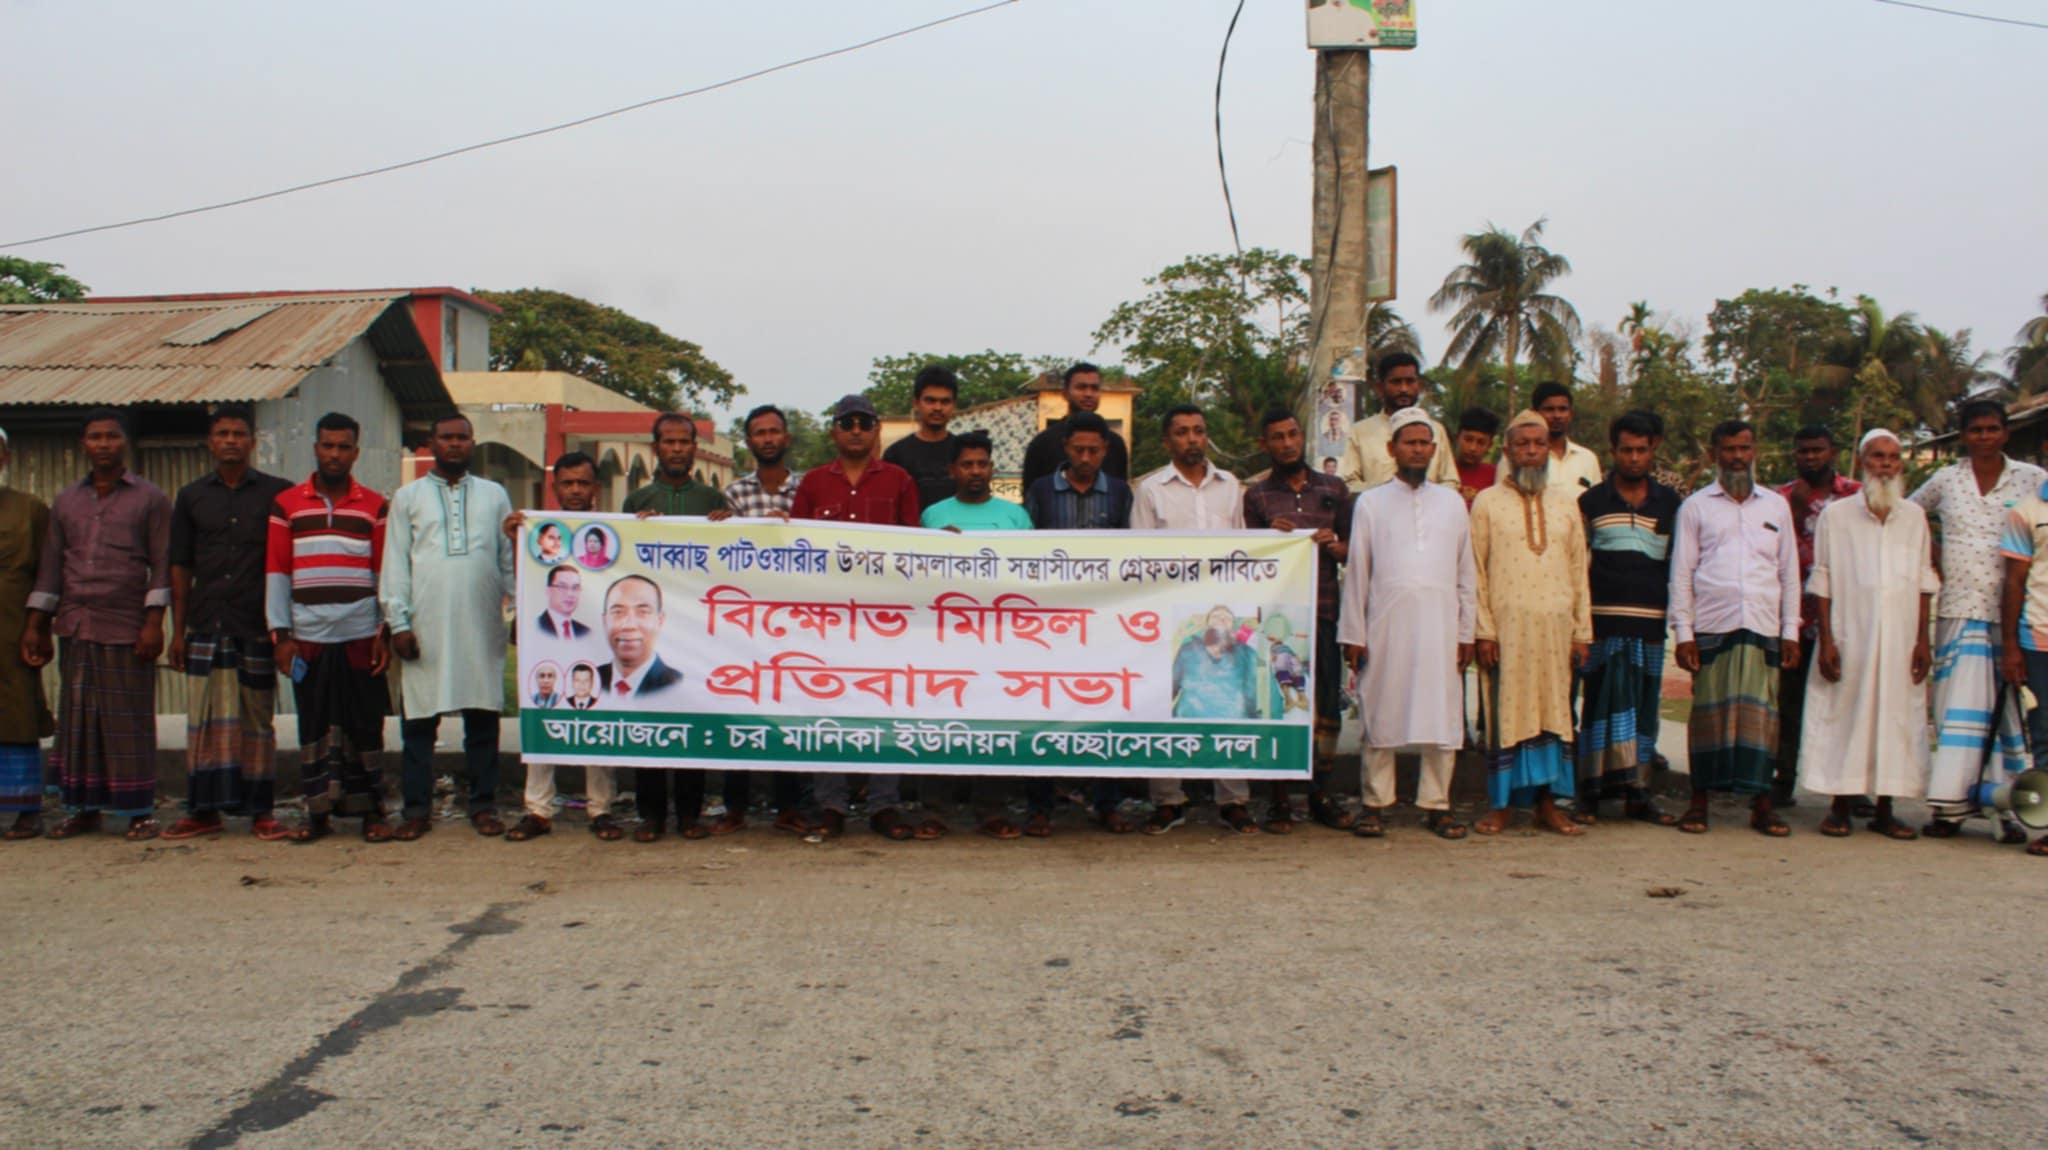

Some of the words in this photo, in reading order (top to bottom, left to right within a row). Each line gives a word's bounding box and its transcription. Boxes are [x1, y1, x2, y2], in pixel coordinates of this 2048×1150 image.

[635, 541, 709, 573] আব্বাছ
[717, 538, 829, 574] পাটওয়ারীর
[836, 541, 886, 577] উপর
[894, 548, 999, 581] হামলাকারী
[1007, 549, 1111, 581] সন্ত্রাসীদের
[1119, 557, 1202, 583] গ্রেফতার
[1208, 550, 1280, 583] দাবিতে
[699, 584, 914, 642] বিক্ষোভ
[927, 591, 1096, 650] মিছিল
[1117, 610, 1161, 643] ও
[706, 651, 979, 709] প্রতিবাদ
[996, 667, 1144, 711] সভা
[542, 718, 693, 749] আয়োজনে
[726, 725, 770, 750] চর
[779, 719, 885, 753] মানিকা
[893, 722, 1020, 756] ইউনিয়ন
[1031, 729, 1204, 759] স্বেচ্ছাসেবক
